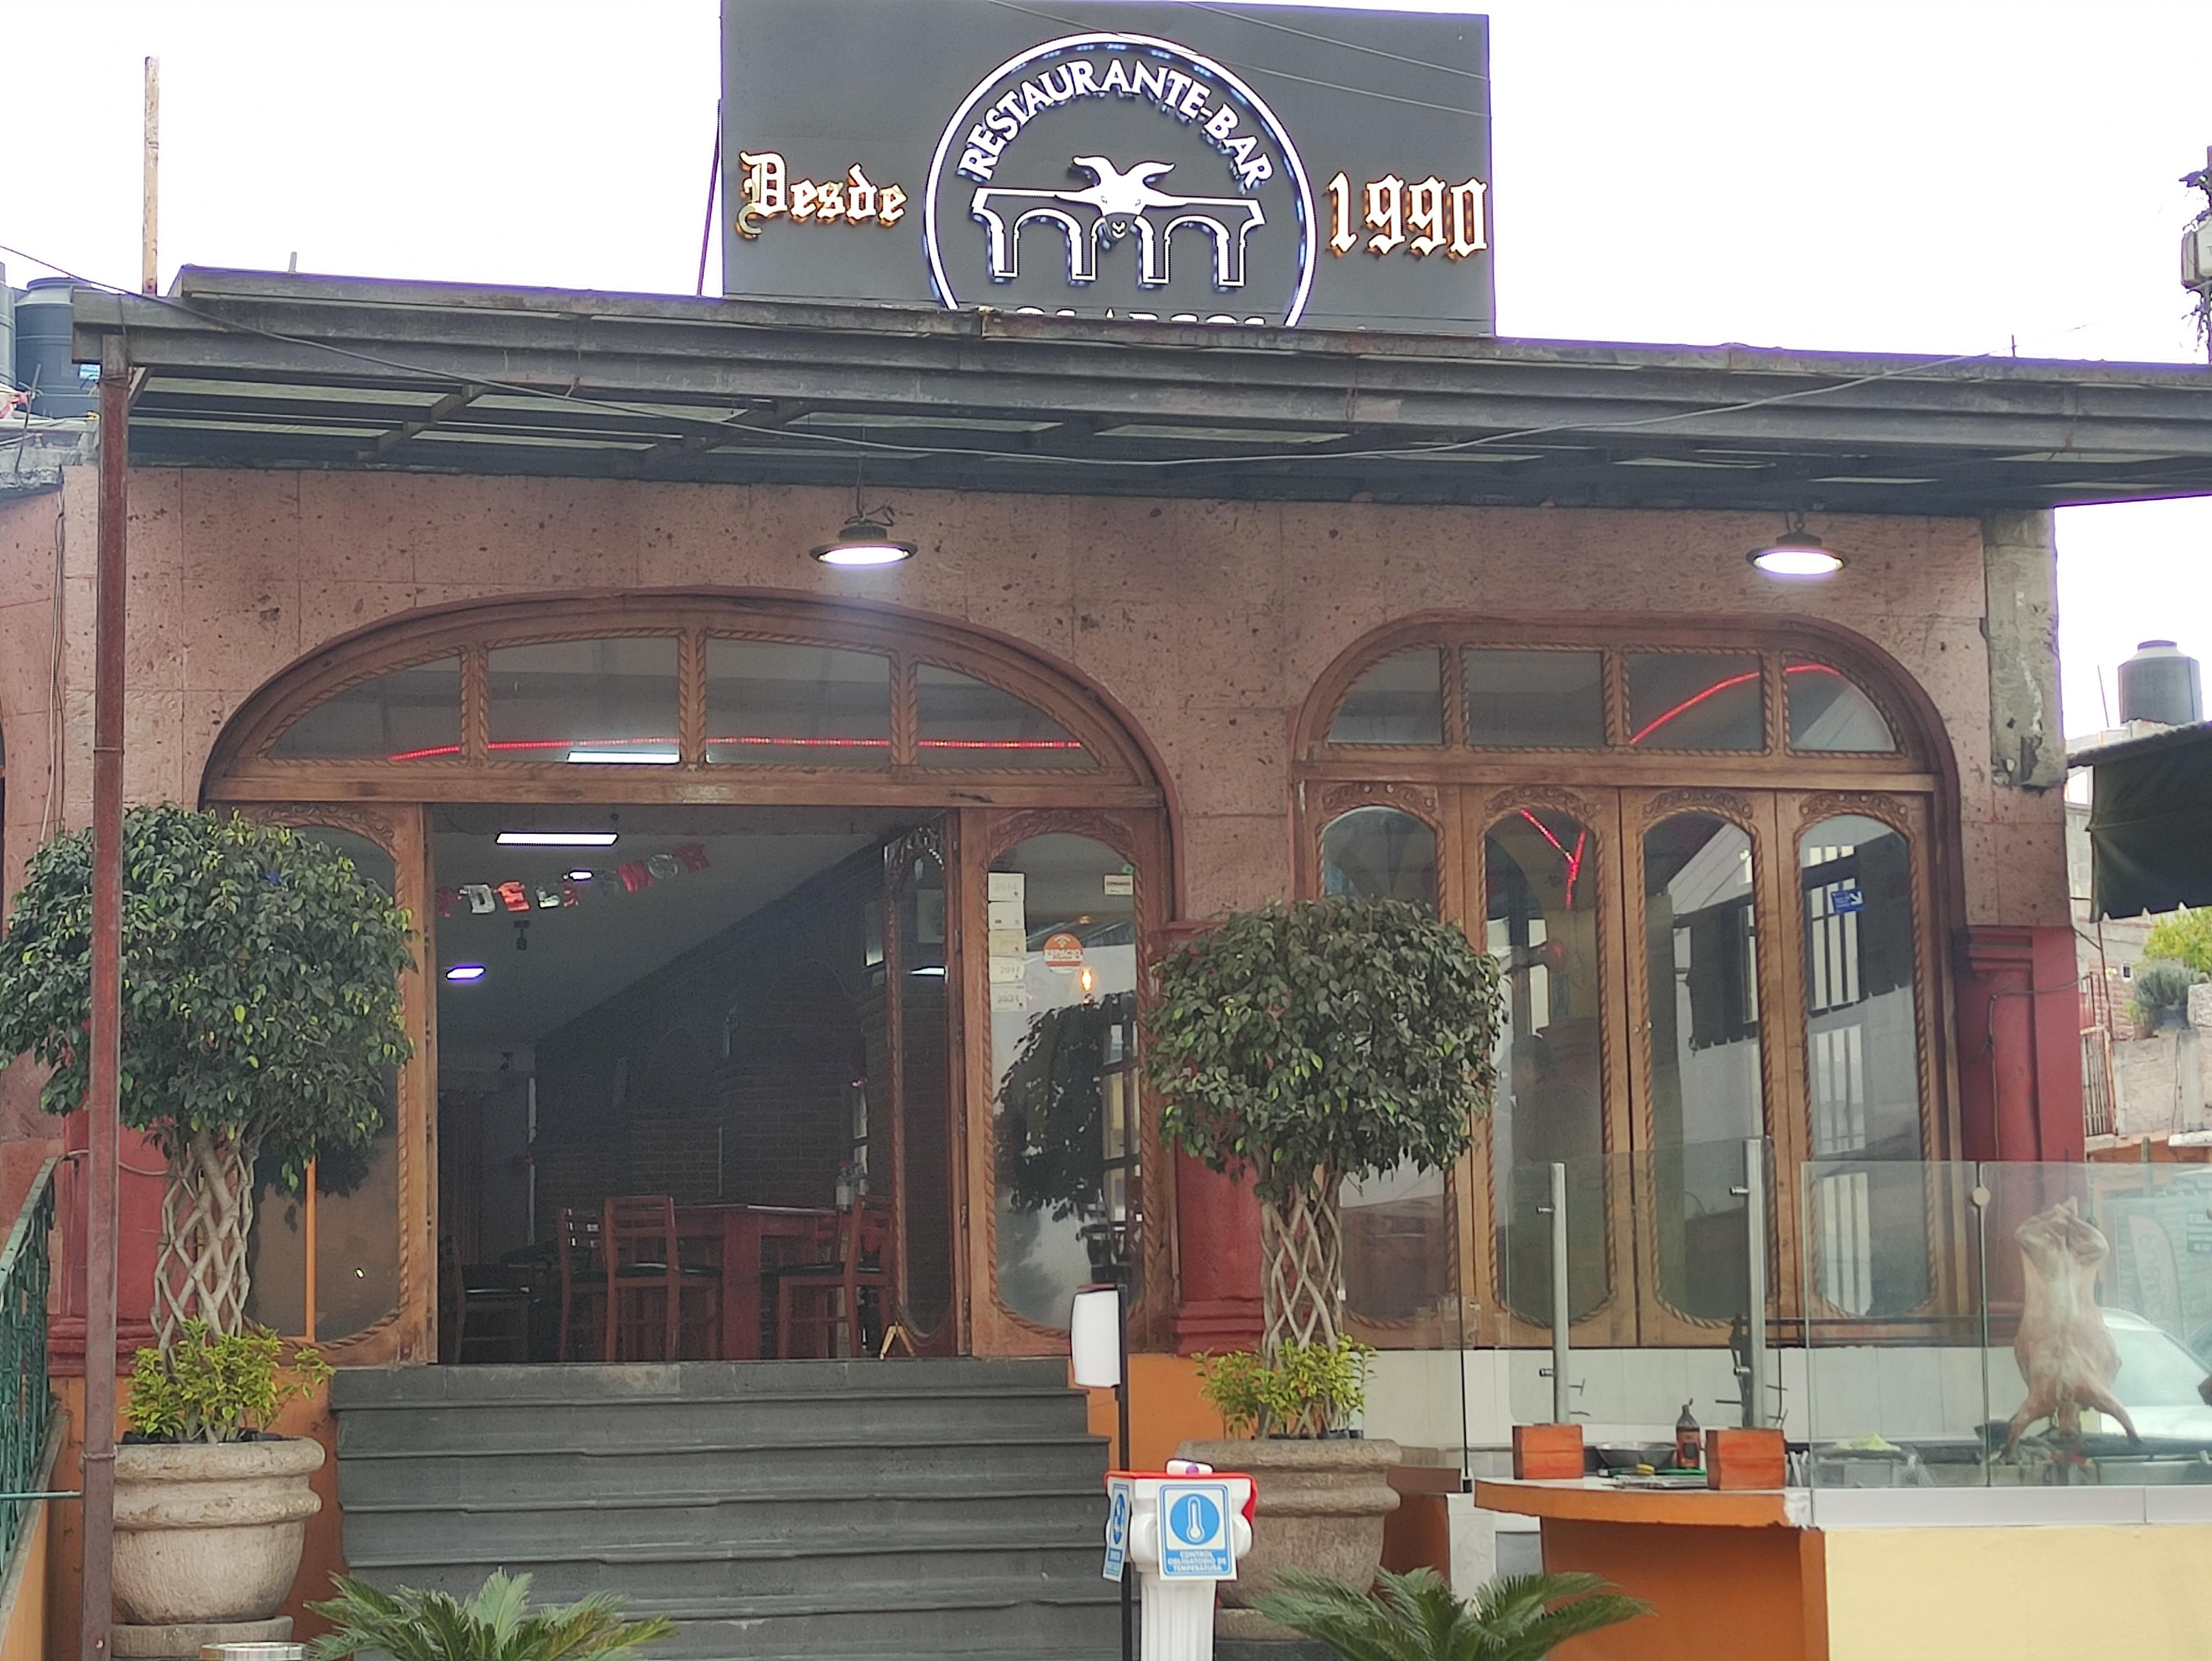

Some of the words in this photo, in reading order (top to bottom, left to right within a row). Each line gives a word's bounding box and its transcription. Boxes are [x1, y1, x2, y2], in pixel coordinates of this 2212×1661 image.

[958, 59, 1274, 189] RESTAURANTE-BAR
[737, 151, 908, 235] Desde
[1328, 171, 1489, 257] 1990
